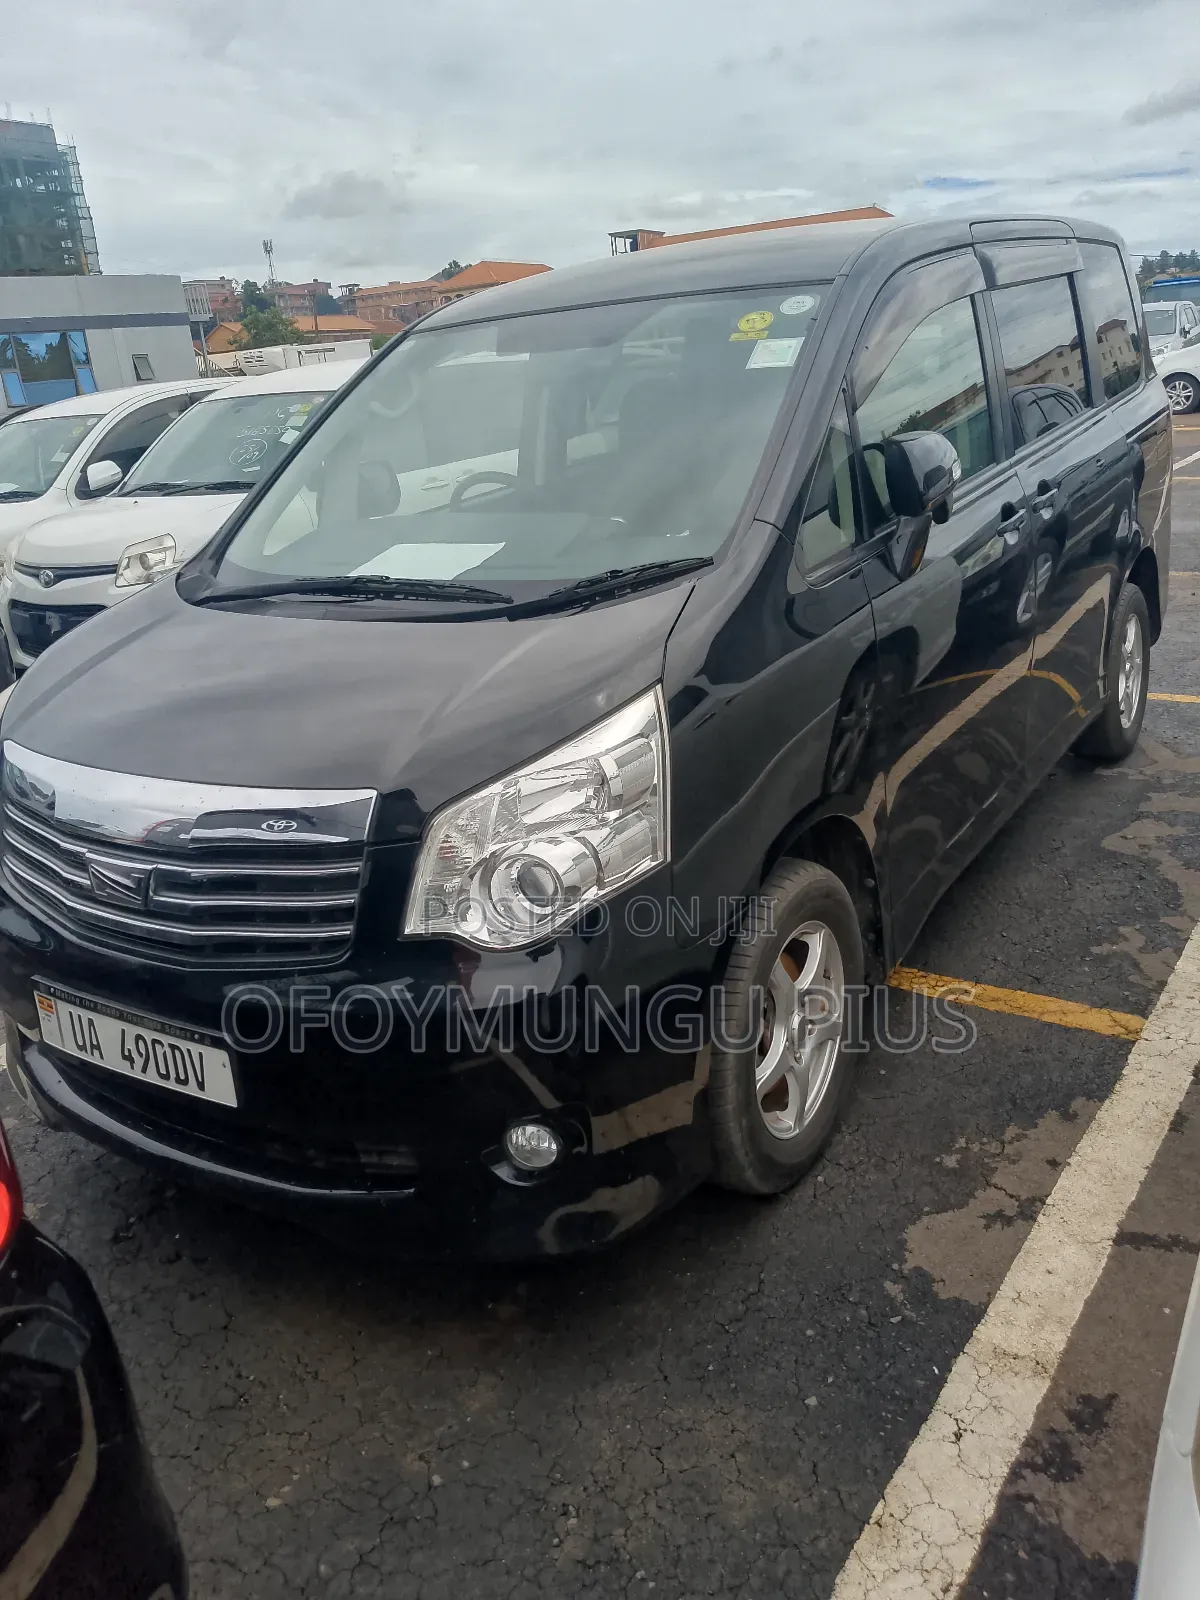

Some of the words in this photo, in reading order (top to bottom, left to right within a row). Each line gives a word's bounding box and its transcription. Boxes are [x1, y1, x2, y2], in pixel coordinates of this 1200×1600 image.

[55, 989, 80, 1005] Making
[82, 999, 95, 1009] the
[97, 1003, 120, 1017] Roads
[69, 1010, 104, 1060] UA
[120, 1028, 206, 1092] 490DV
